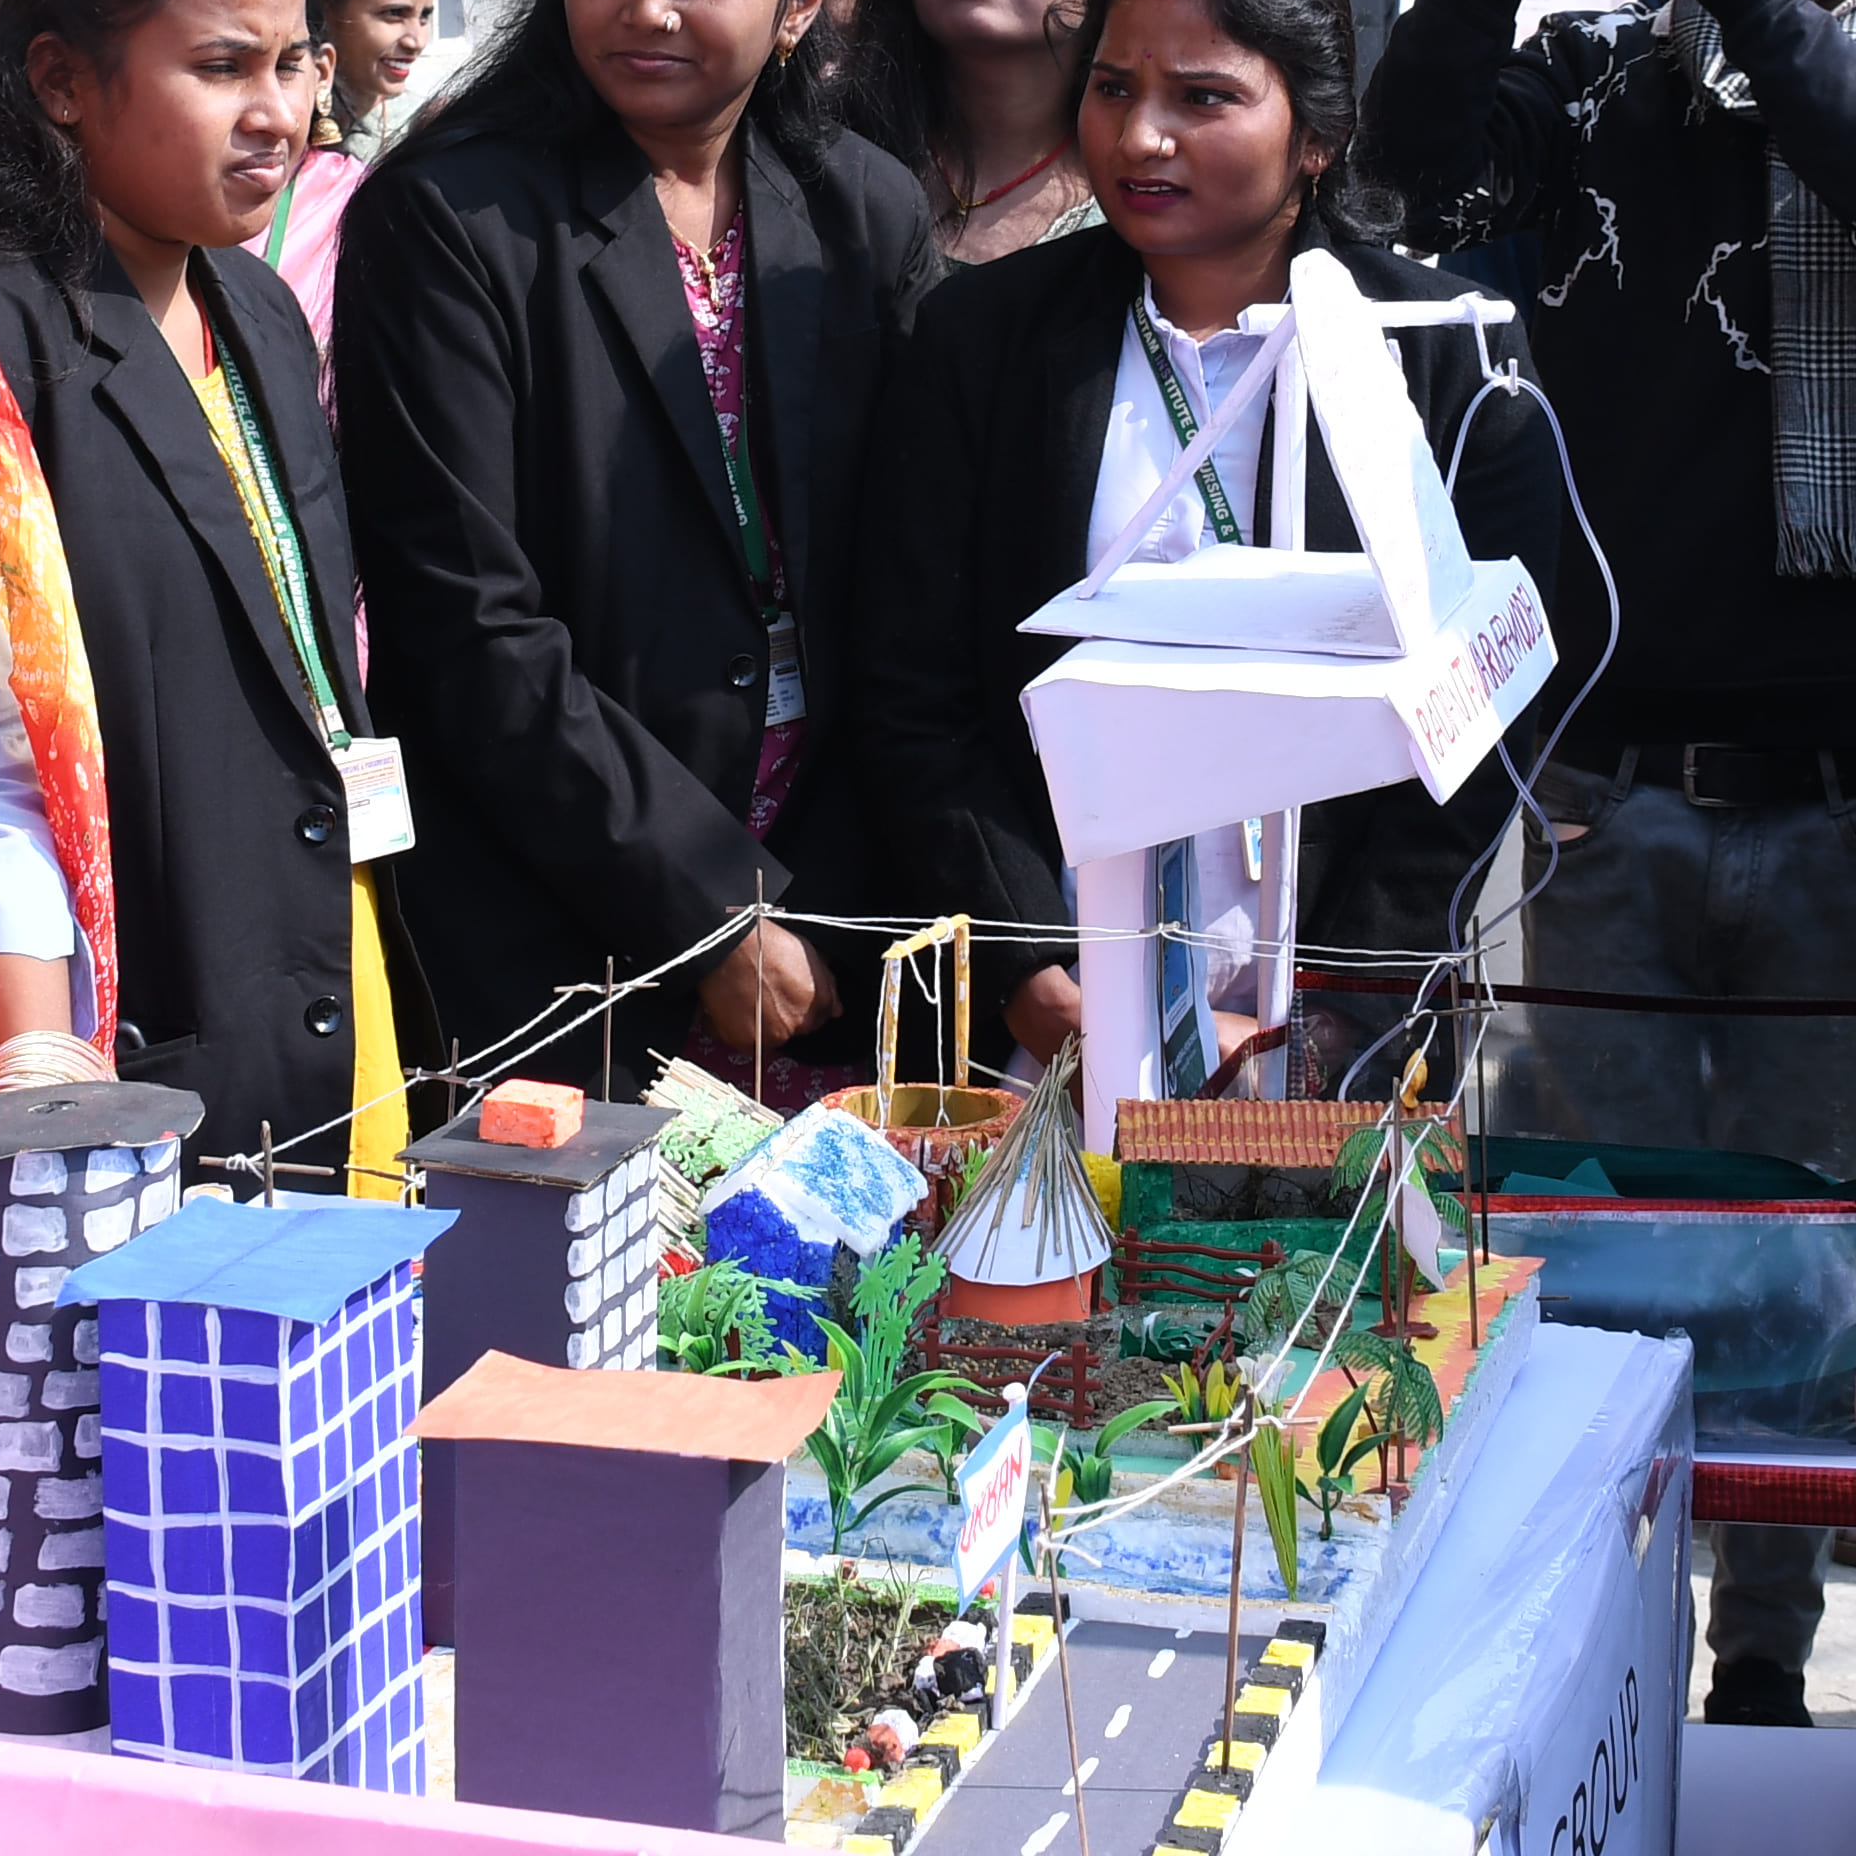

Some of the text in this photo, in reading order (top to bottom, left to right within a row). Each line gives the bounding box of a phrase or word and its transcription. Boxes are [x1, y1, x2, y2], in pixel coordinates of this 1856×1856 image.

[244, 419, 261, 440] OF
[1134, 296, 1160, 354] GAUTAM
[1155, 354, 1193, 429] INSTITUTE
[1200, 457, 1229, 521] URSING
[1220, 523, 1234, 537] &
[251, 443, 284, 518] NURSING
[274, 521, 288, 535] &
